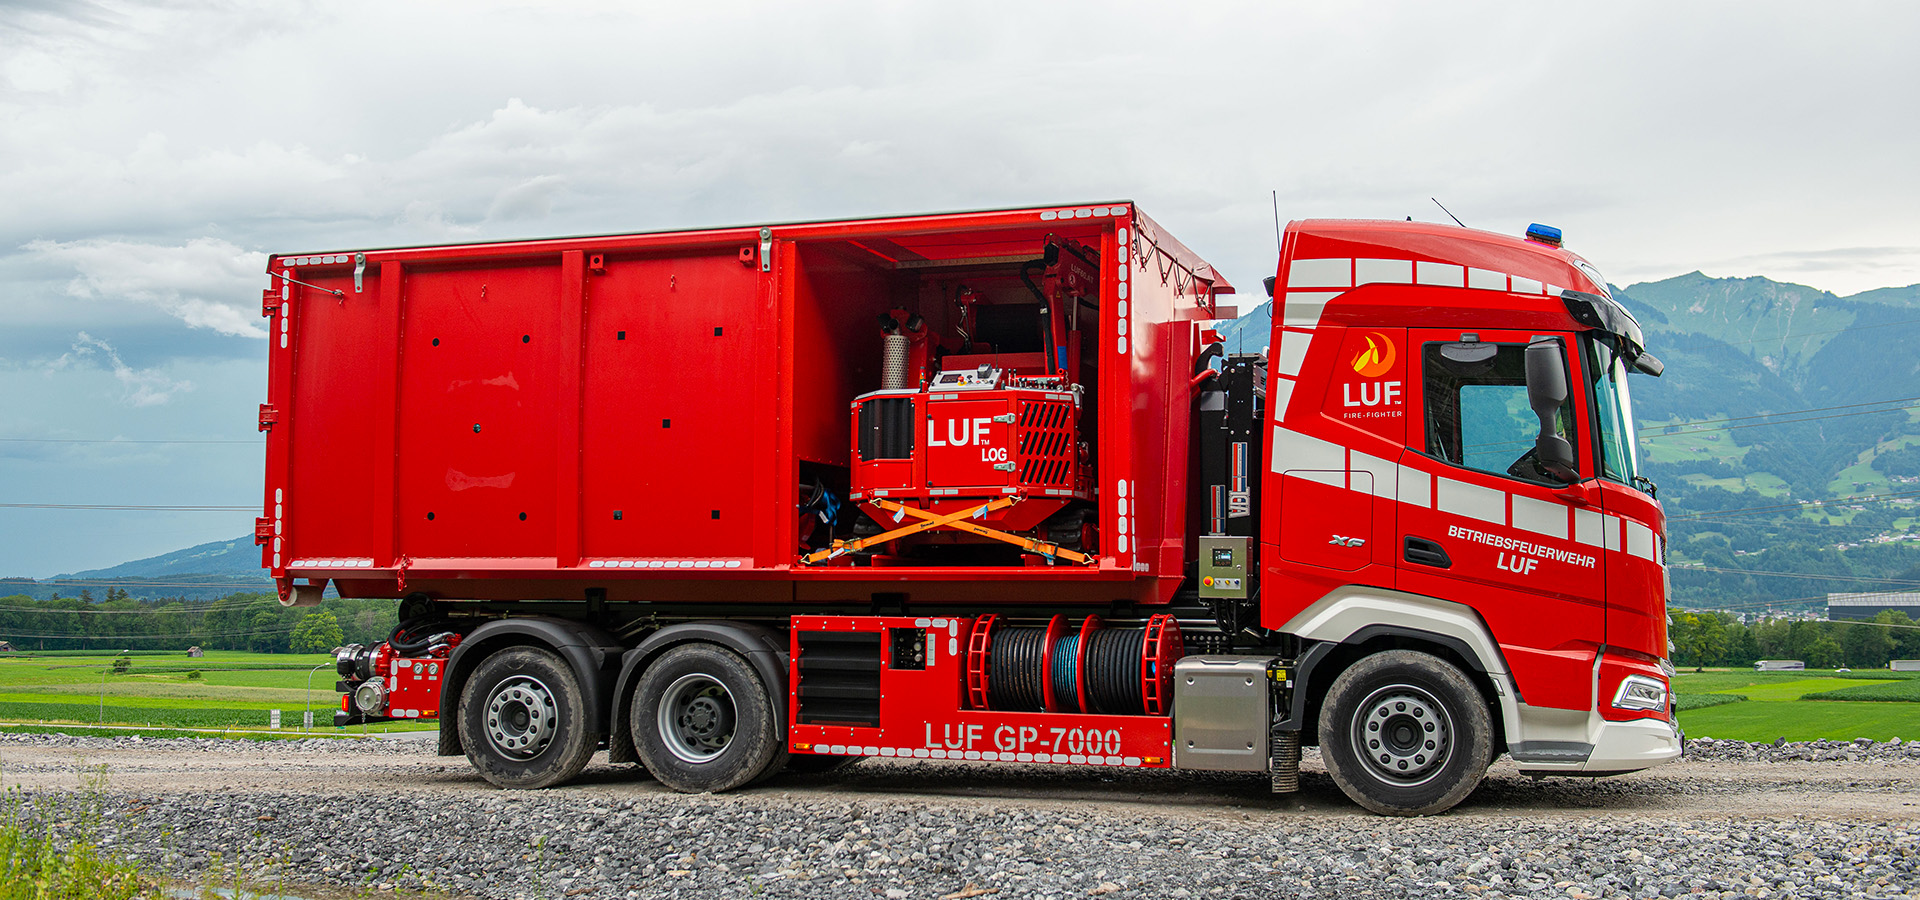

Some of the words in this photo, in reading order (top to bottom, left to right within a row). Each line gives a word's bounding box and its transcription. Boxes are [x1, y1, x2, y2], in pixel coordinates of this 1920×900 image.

[1343, 381, 1401, 407] LUF
[1343, 411, 1402, 419] FIRE-FIGHTER
[928, 417, 992, 447] LUF
[981, 447, 1007, 462] LOG
[1228, 486, 1251, 519] VDL
[1328, 534, 1366, 547] XF
[1448, 525, 1596, 569] BETRIEBSFEUERWEHR
[1496, 552, 1539, 575] LUF
[925, 723, 984, 749] LUF
[993, 725, 1121, 755] GP-7000
